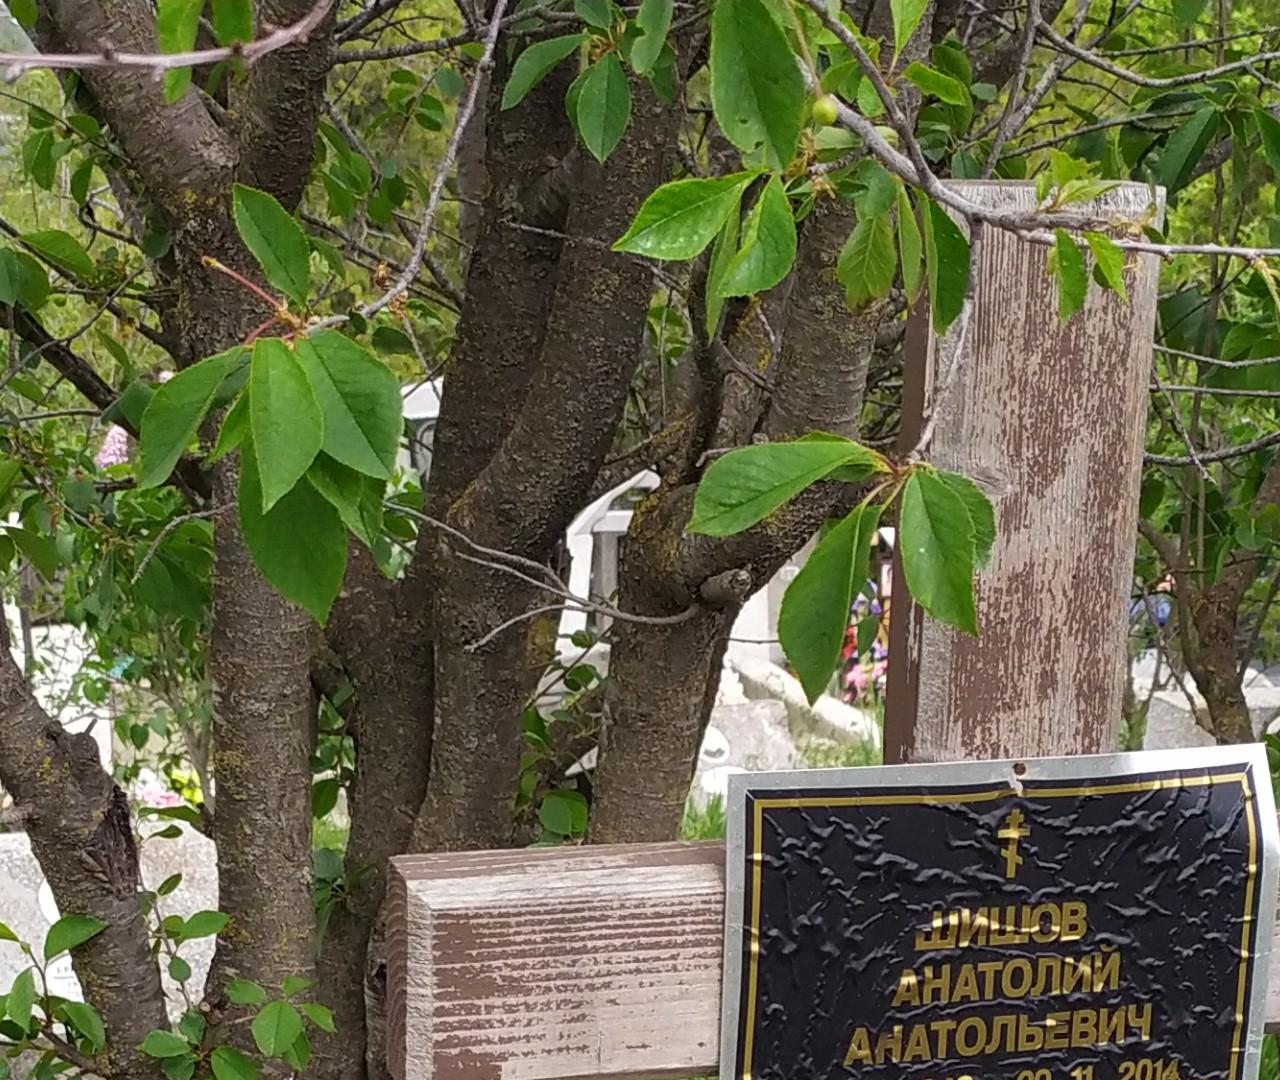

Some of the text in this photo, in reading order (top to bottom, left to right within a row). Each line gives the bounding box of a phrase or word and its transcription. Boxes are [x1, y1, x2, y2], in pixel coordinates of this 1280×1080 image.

[914, 902, 1088, 951] ШИШОВ
[891, 944, 1121, 1007] АНАТОЛИЙ
[843, 1003, 1153, 1067] АНАТОЛЬЕВИЧ
